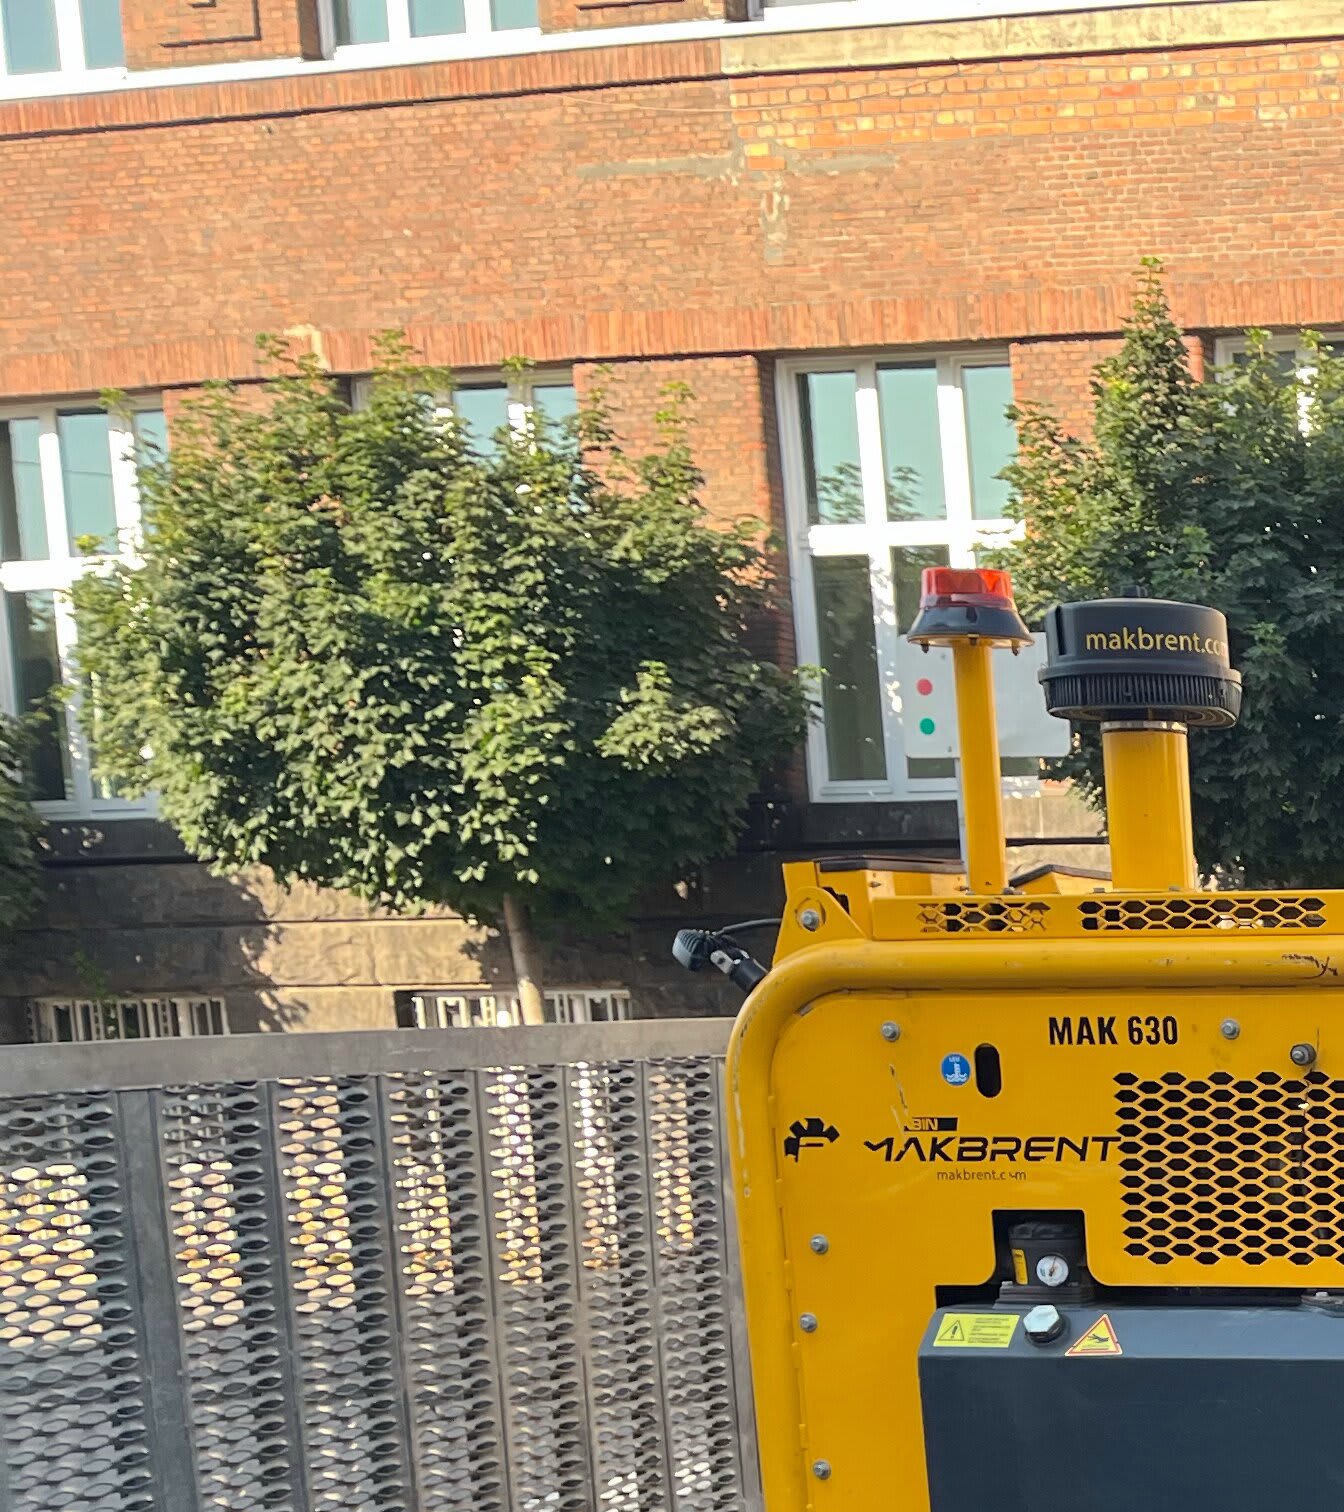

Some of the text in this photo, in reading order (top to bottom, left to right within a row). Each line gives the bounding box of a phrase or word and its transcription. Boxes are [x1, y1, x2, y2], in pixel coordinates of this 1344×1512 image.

[1048, 1016, 1178, 1046] MAK 630
[863, 1136, 1122, 1162] MAKBRENT
